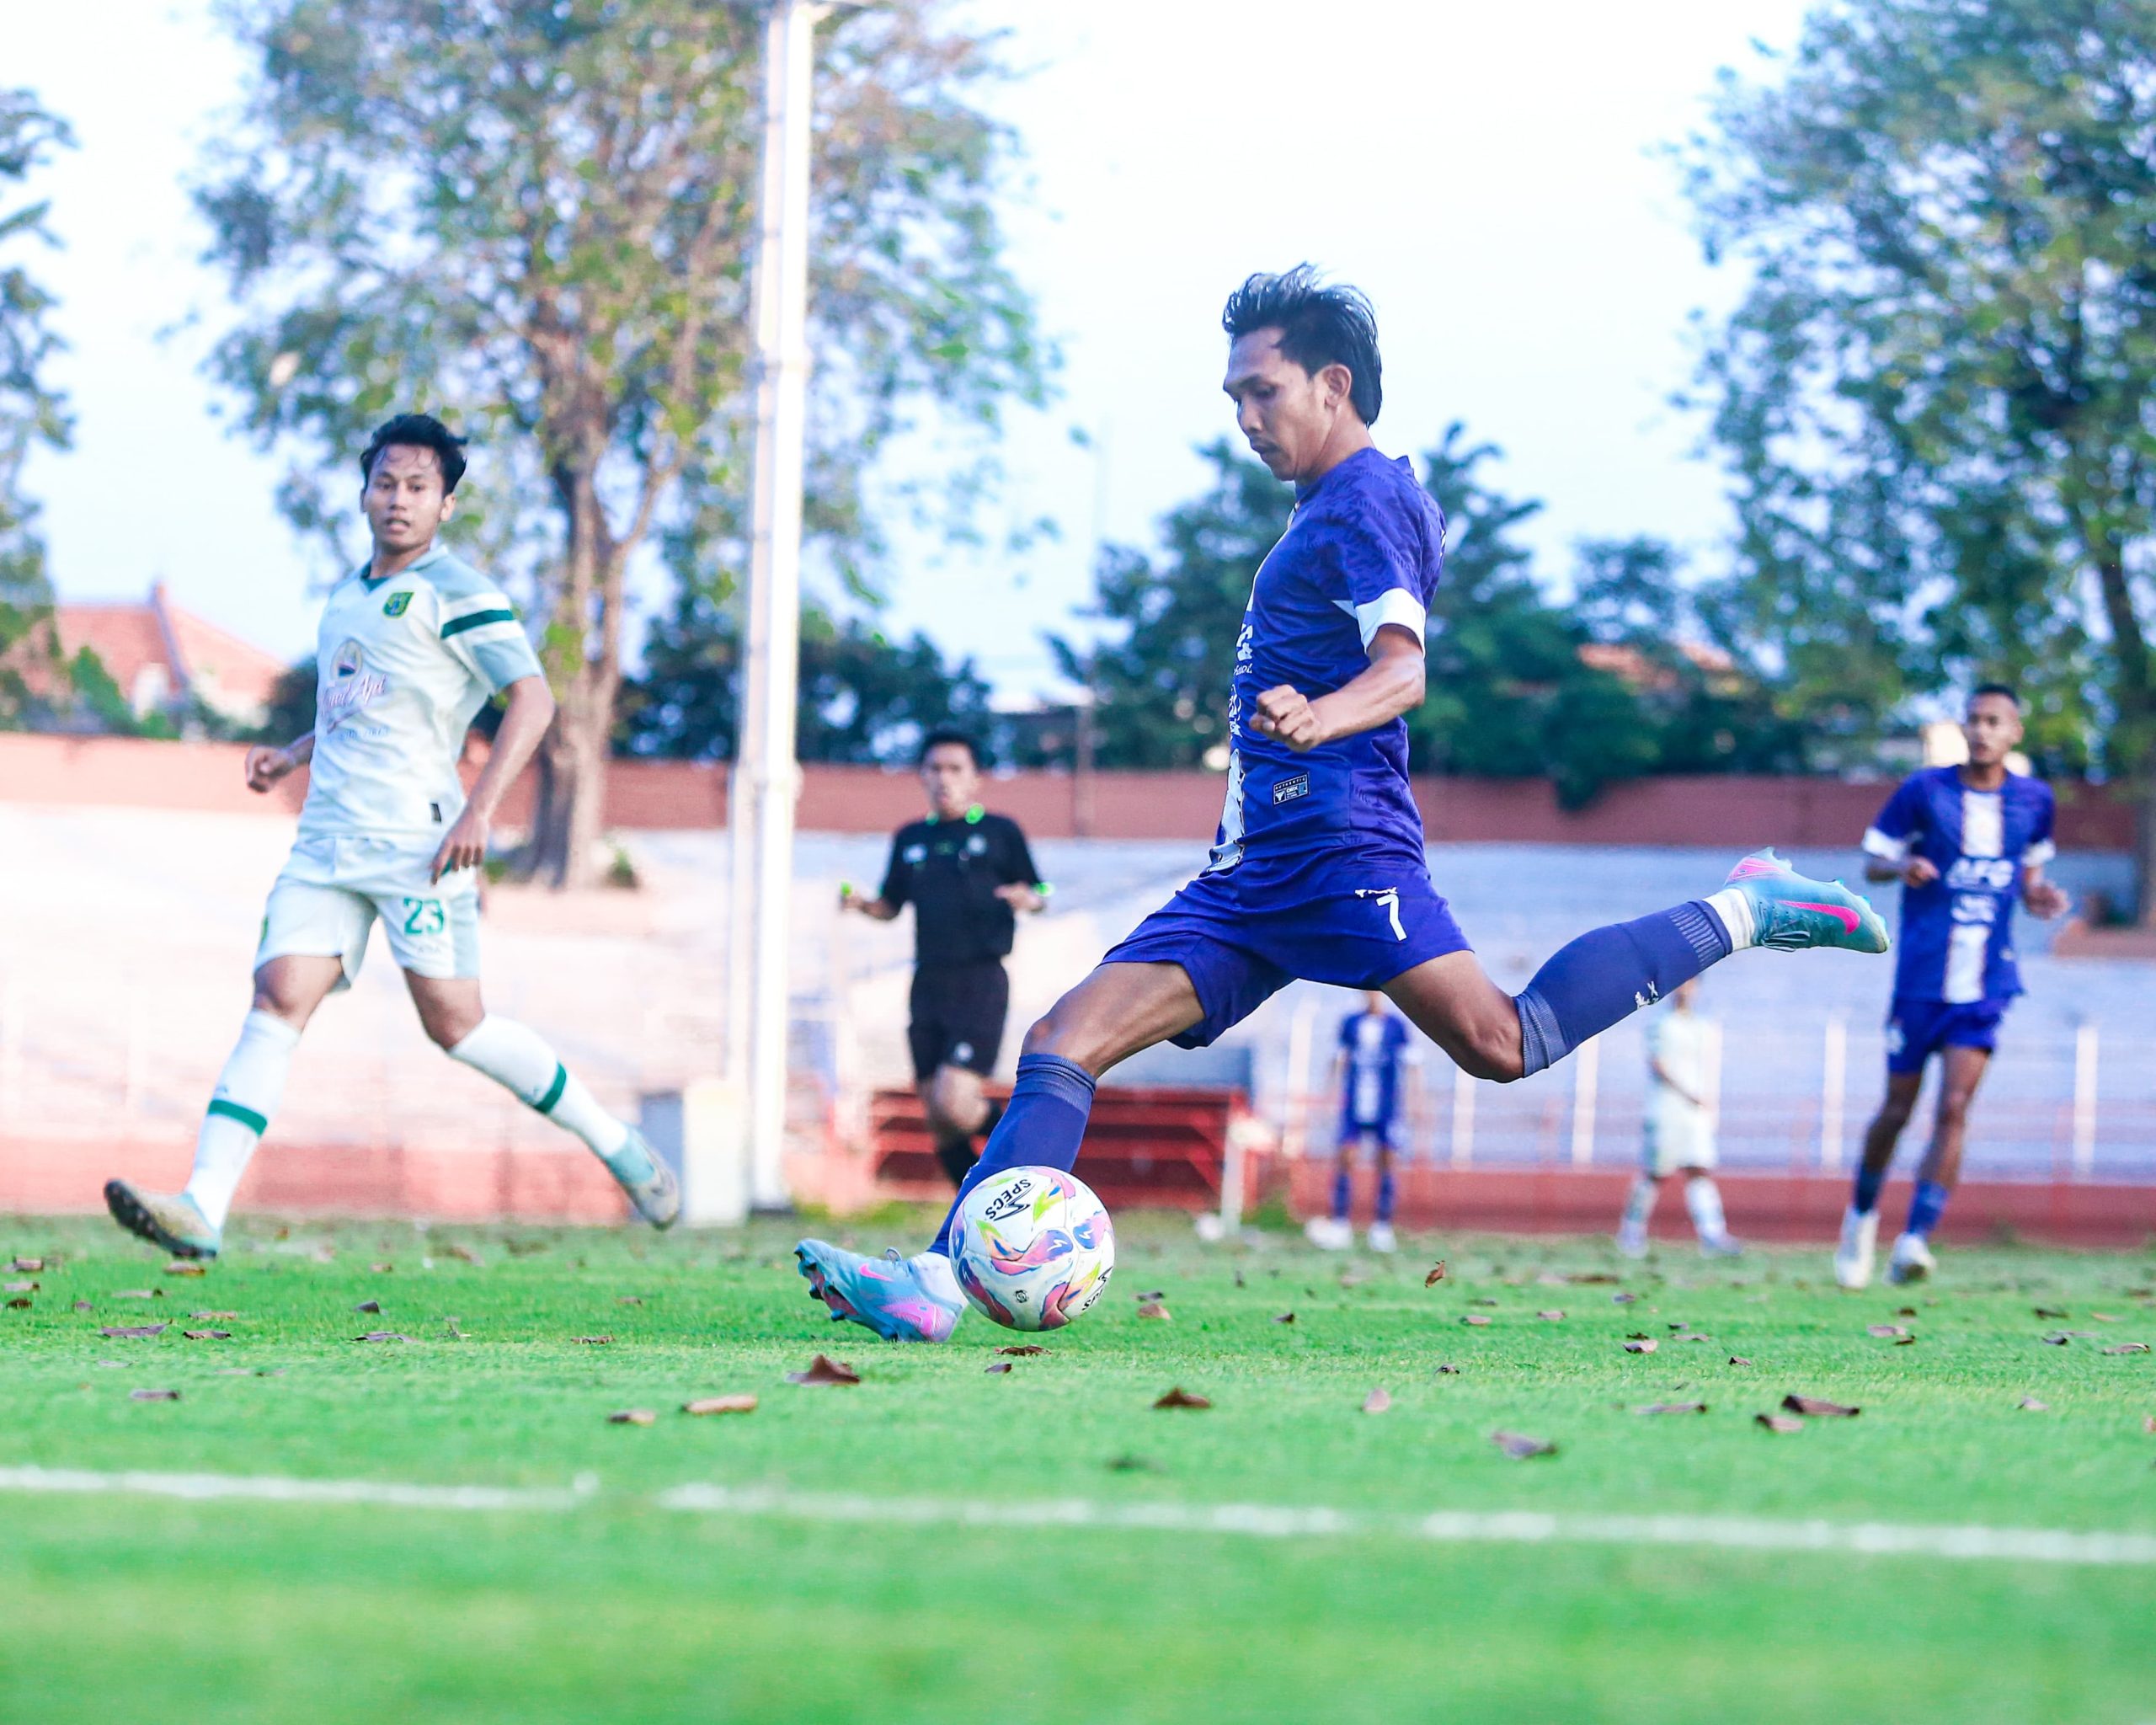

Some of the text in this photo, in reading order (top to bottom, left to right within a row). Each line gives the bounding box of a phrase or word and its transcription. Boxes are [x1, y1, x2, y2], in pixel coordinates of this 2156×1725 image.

[403, 897, 444, 935] 23
[1375, 893, 1407, 942] 7
[985, 1178, 1032, 1220] SPECS
